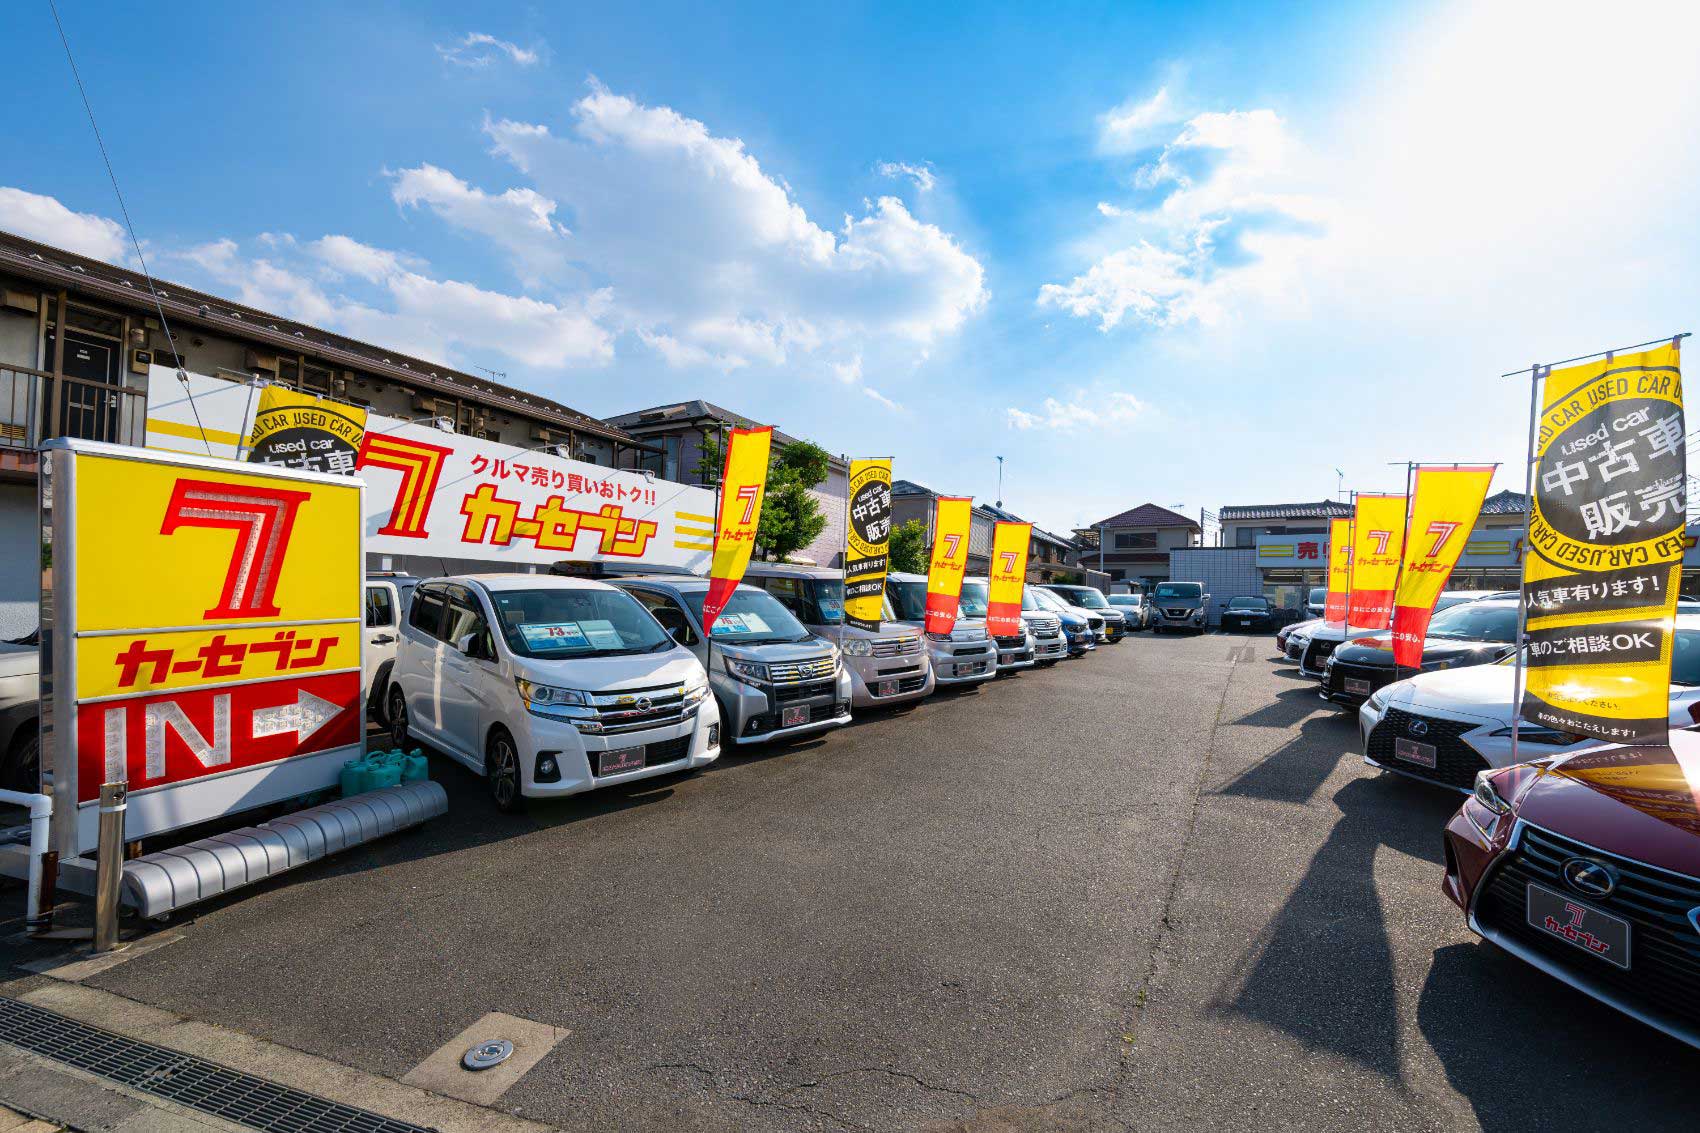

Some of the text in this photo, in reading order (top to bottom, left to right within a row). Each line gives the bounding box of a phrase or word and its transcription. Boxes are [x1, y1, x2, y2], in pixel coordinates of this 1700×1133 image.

[1551, 400, 1584, 427] CAR
[1587, 377, 1629, 406] USED
[1637, 375, 1671, 395] CAR
[263, 414, 289, 430] CAR
[293, 412, 326, 427] USED
[329, 418, 352, 437] CAR
[1561, 406, 1651, 456] used car
[269, 439, 335, 453] used car
[1541, 411, 1686, 496] 中古車
[854, 476, 865, 489] CAR
[865, 470, 877, 480] USED
[879, 471, 888, 480] CAR
[736, 484, 761, 525] 7
[852, 489, 891, 522] 中古車
[858, 484, 883, 503] used car
[1579, 473, 1687, 540] 販売
[460, 483, 658, 557] カーセブン
[866, 515, 891, 542] 販売
[722, 528, 757, 541] カーセブン
[944, 534, 963, 559] 7
[1367, 530, 1394, 555] 7
[1426, 521, 1462, 558] 7
[160, 478, 312, 620] 7
[1000, 551, 1020, 573] 7
[1358, 557, 1399, 567] カーセブン
[1556, 542, 1599, 567] USED
[1609, 546, 1649, 566] CAR
[1408, 561, 1453, 575] カーセブン
[1527, 575, 1661, 608] 人気車有ります!
[1529, 632, 1656, 658] 車のご相談OK
[115, 631, 339, 688] カーセブン
[104, 693, 232, 785] IN
[1545, 916, 1610, 953] カーセブン
